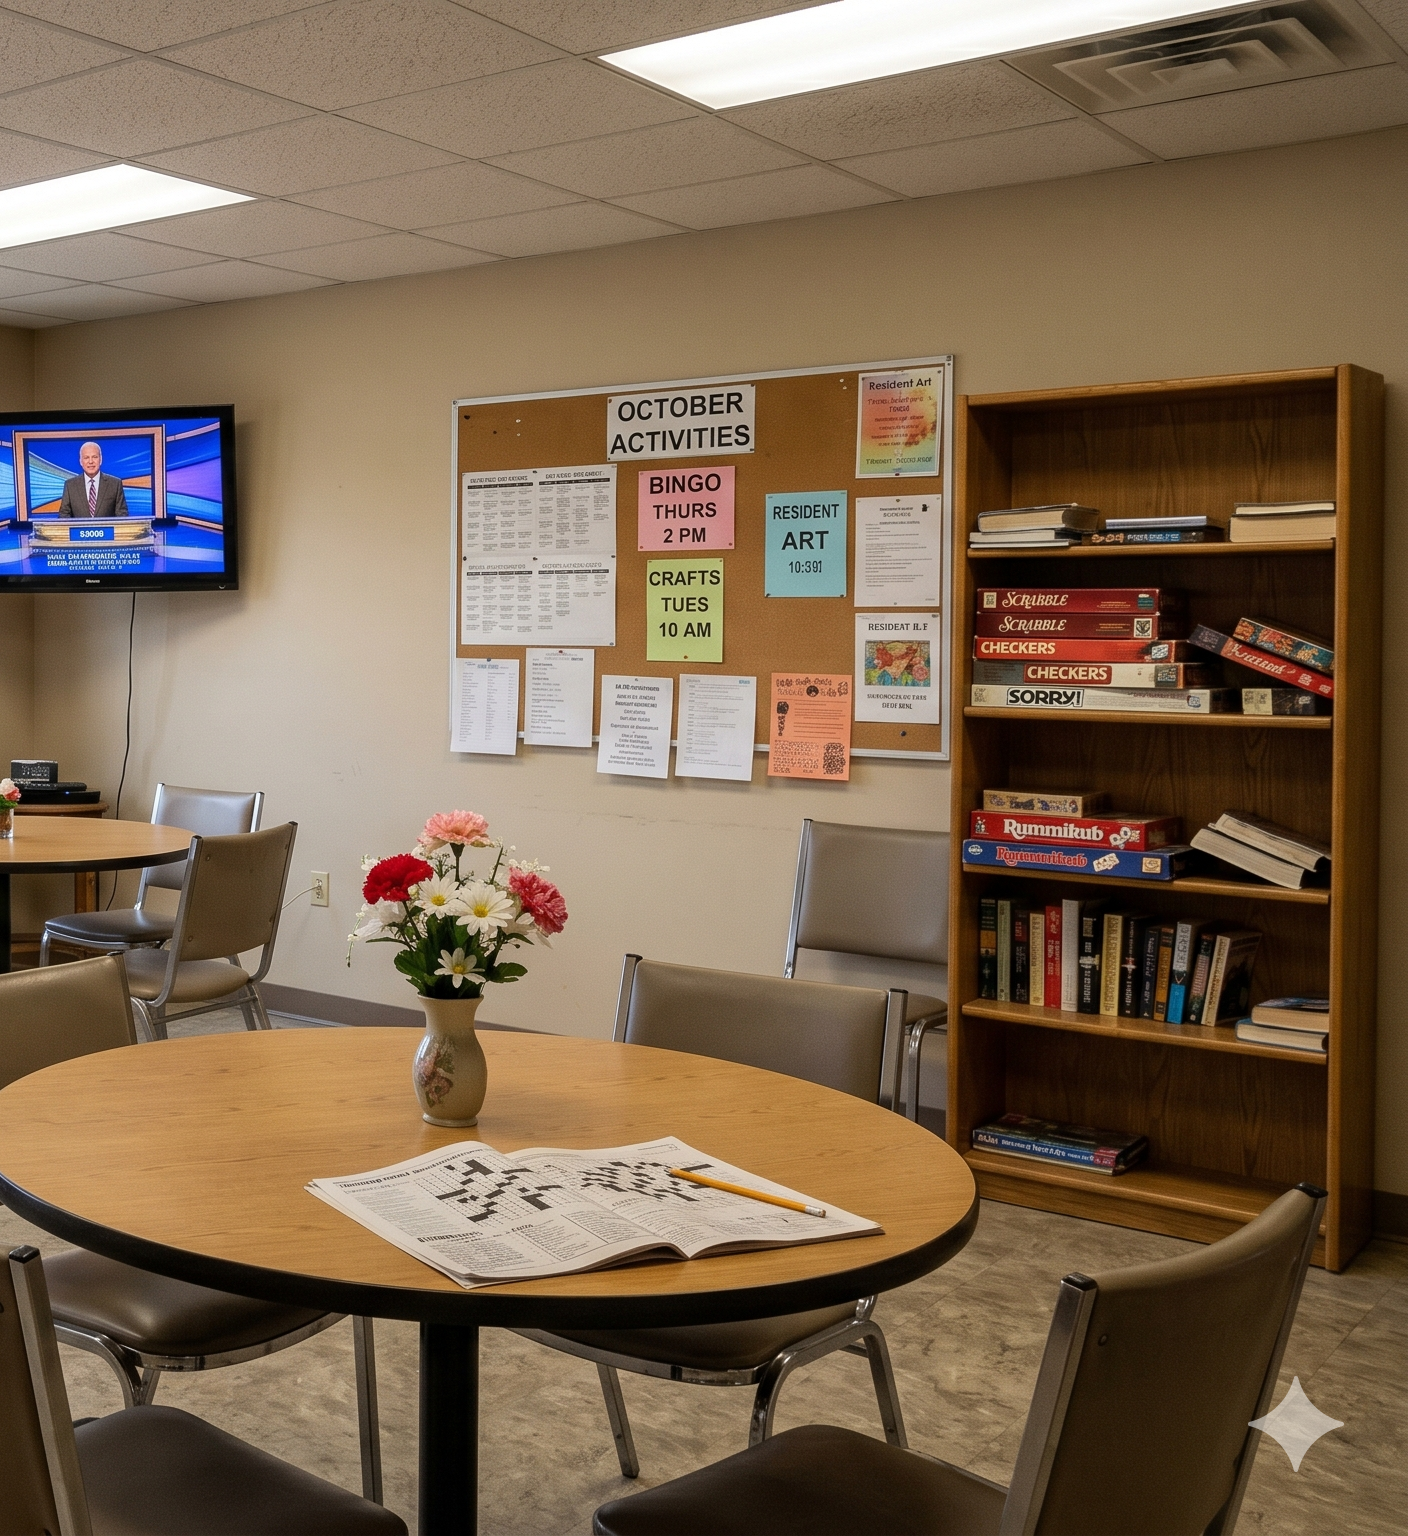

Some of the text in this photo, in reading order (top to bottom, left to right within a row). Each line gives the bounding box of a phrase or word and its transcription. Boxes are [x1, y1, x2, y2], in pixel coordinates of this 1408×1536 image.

[869, 378, 932, 391] Resident Art
[618, 392, 744, 422] OCTOBER
[610, 424, 750, 455] ACTIVITIES
[649, 473, 721, 495] BINGO
[653, 502, 717, 519] THURS
[773, 504, 840, 520] RESIDENT
[663, 527, 706, 543] 2 PM
[781, 530, 829, 550] ART
[649, 570, 721, 586] CRAFTS
[661, 597, 709, 612] TUES
[659, 622, 711, 638] 10 AM
[980, 641, 1056, 655] CHECKERS
[1027, 667, 1108, 681] CHECKERS
[1008, 689, 1081, 705] SORRY!
[1003, 818, 1104, 841] Rummikub
